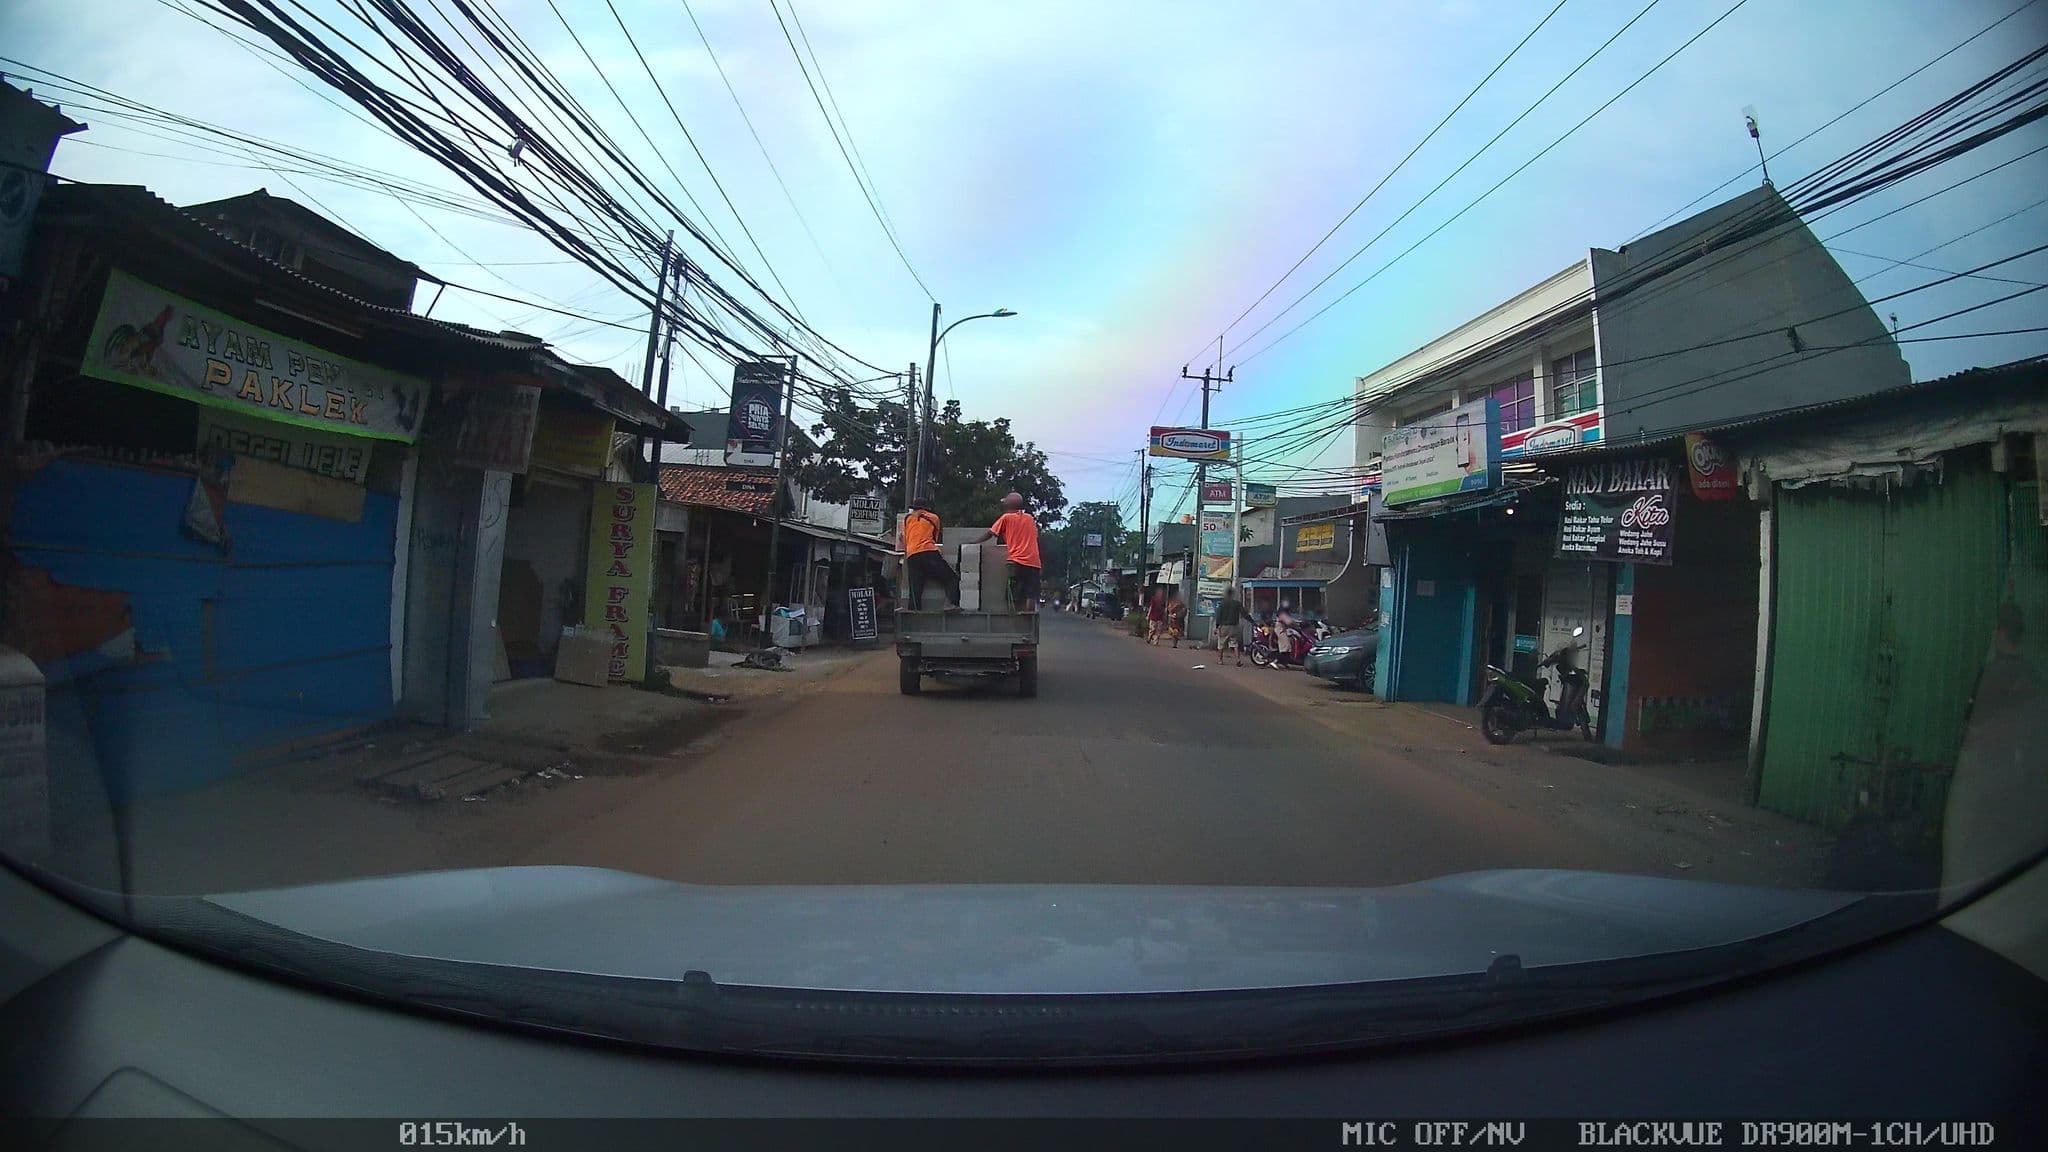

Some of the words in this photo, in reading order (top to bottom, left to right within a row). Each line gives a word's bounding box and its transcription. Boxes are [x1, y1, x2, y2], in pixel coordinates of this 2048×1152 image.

[180, 315, 274, 370] AYAM
[201, 357, 368, 425] PAKLEK
[1165, 437, 1217, 449] Indomaret
[1529, 431, 1573, 449] Indomaret
[1566, 463, 1604, 494] NASI
[1607, 459, 1670, 493] BAKAR
[1209, 489, 1226, 498] ATM
[852, 499, 880, 509] MOLAZ
[1565, 501, 1582, 511] Sedia
[606, 486, 637, 578] SURYA
[1203, 523, 1216, 531] 50
